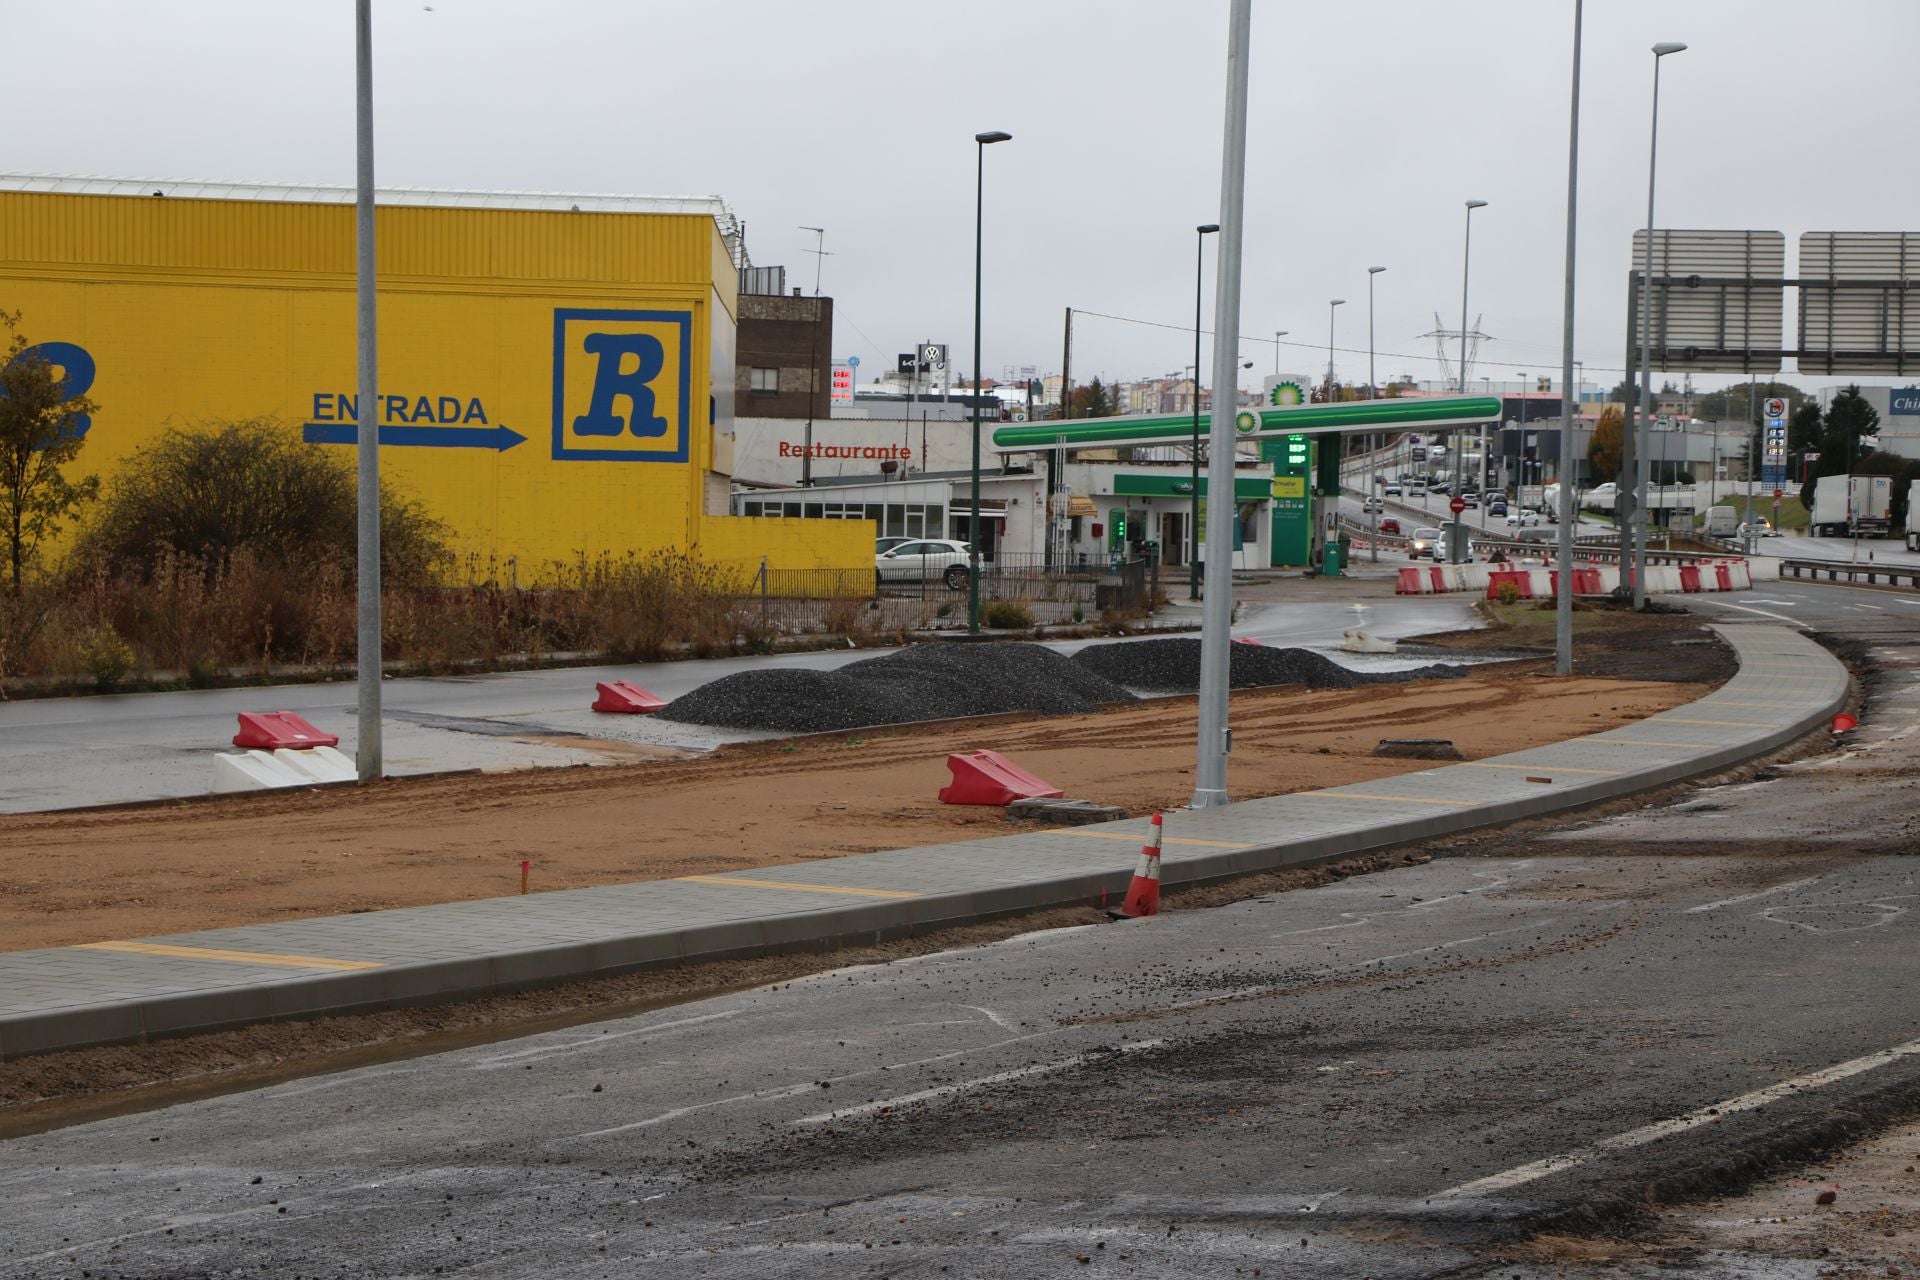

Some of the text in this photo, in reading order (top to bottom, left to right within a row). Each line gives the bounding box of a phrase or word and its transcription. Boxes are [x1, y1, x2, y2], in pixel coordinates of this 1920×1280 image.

[573, 333, 667, 438] R
[313, 393, 488, 425] ENRADA
[779, 441, 912, 460] Restaurante
